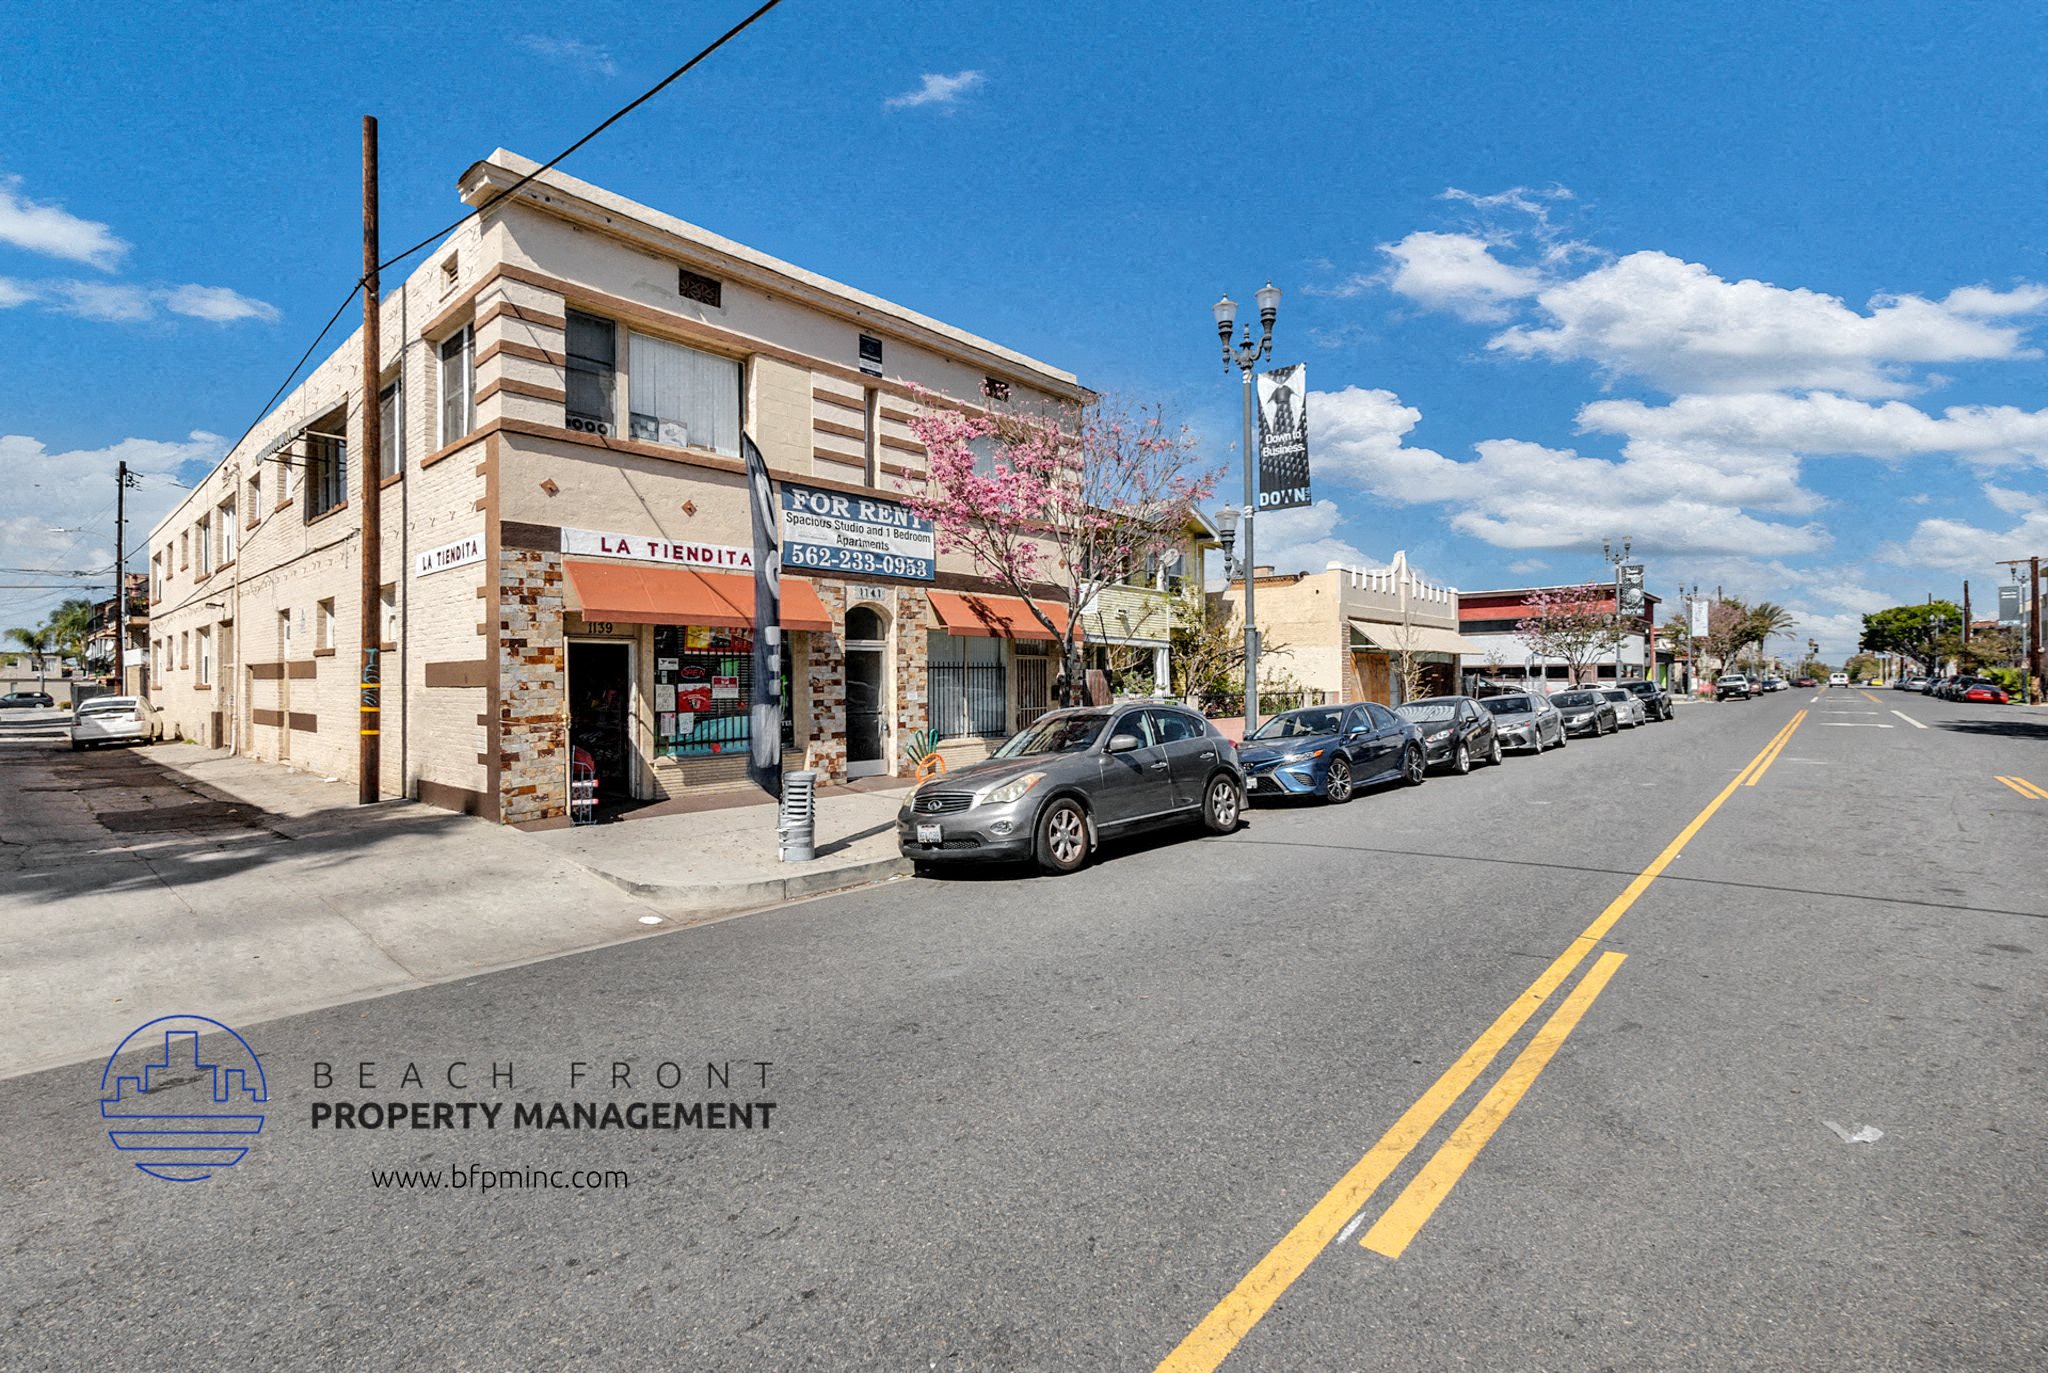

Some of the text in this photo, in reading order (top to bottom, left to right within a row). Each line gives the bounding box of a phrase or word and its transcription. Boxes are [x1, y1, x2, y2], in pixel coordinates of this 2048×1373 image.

[1262, 443, 1306, 457] Business.
[1266, 428, 1302, 444] Down to
[791, 488, 923, 529] FOR RENT
[786, 512, 832, 530] Spacious
[834, 519, 865, 534] Studio
[866, 526, 883, 537] and
[893, 528, 931, 544] Bedroom
[836, 534, 890, 552] Apartments
[422, 539, 478, 571] LA TIENDITA
[601, 536, 752, 567] LA TIENDITA
[791, 544, 928, 578] 562-233-0953
[588, 622, 613, 635] 1139
